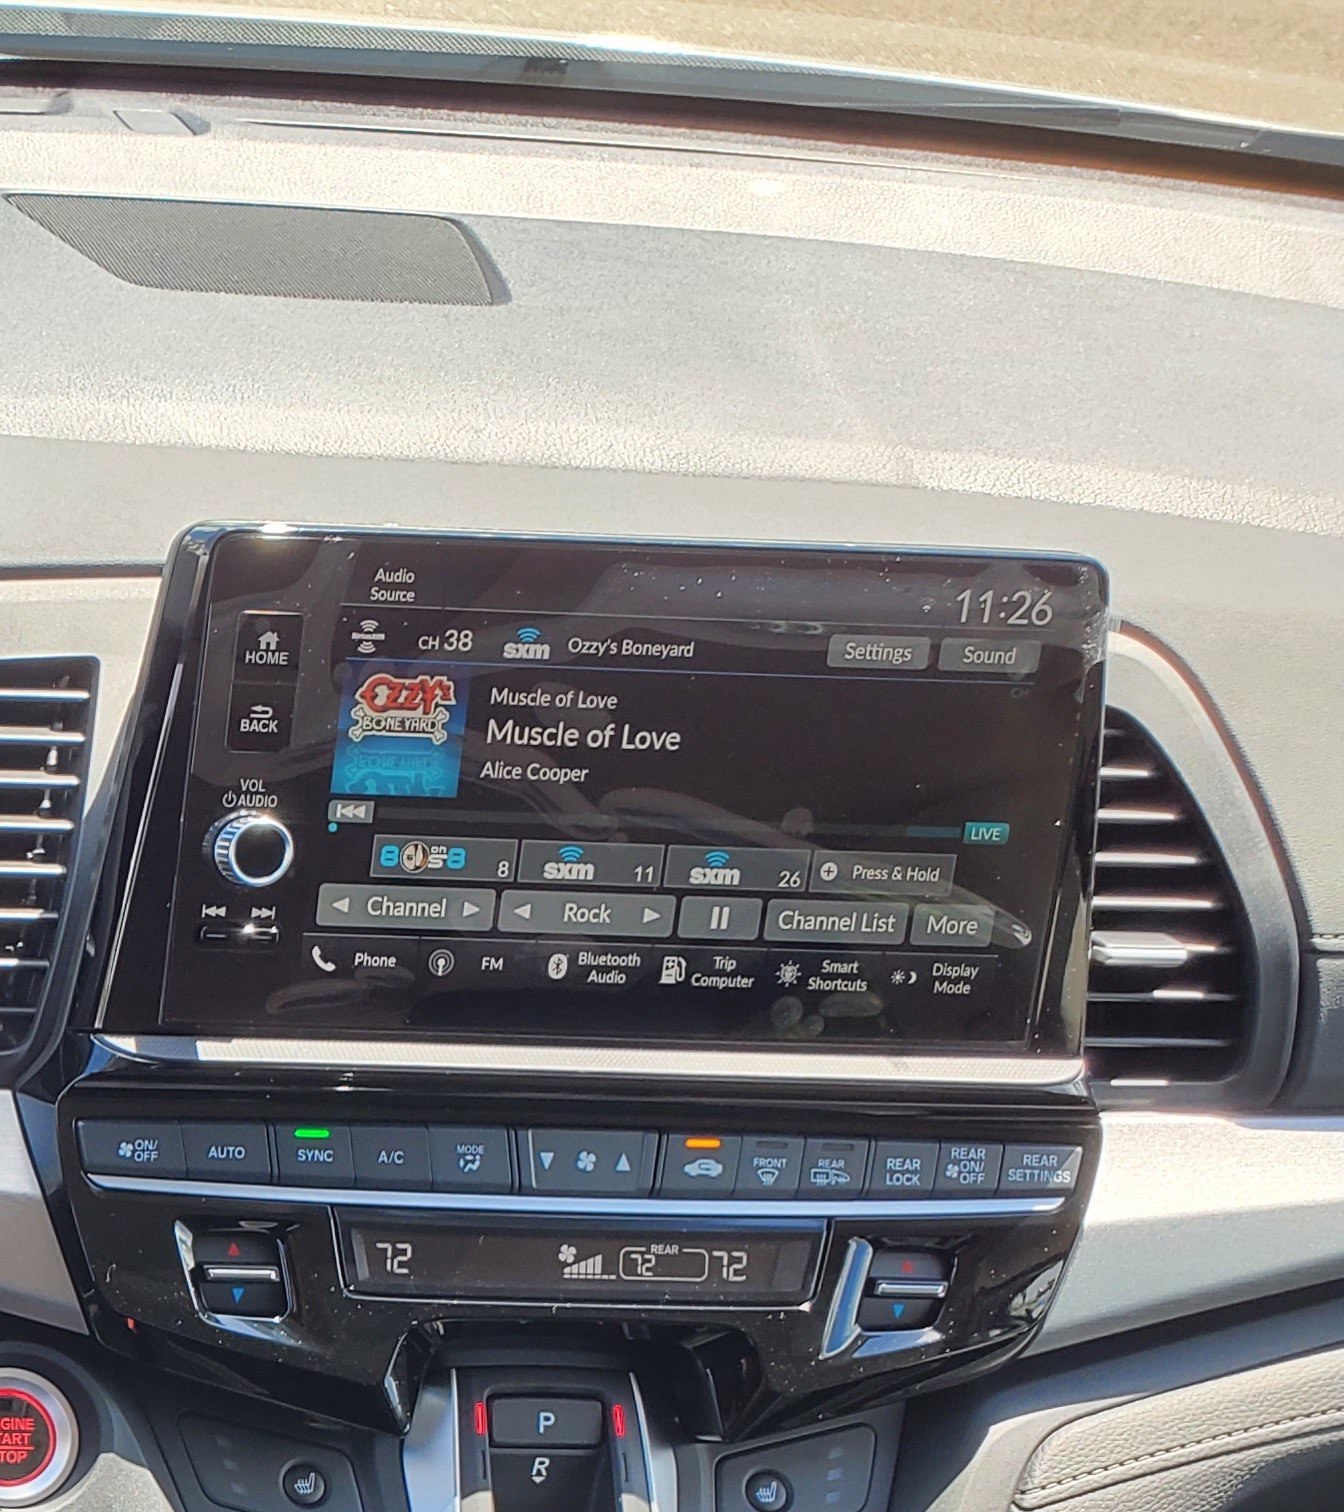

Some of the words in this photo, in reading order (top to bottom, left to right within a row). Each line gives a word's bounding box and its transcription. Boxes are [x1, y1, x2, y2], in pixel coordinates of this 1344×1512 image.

[374, 568, 415, 584] Audio
[370, 587, 416, 602] Source
[955, 588, 1055, 626] 11:26
[418, 635, 440, 651] CH
[443, 629, 474, 652] 38
[568, 636, 617, 658] Ozzy's
[621, 639, 695, 659] Boneyard
[244, 649, 290, 666] HOME
[843, 642, 913, 665] Settings
[962, 646, 1018, 666] Sound
[489, 687, 551, 707] Muscle
[555, 690, 576, 708] of
[577, 691, 618, 710] Love
[239, 718, 279, 734] BACK
[361, 716, 439, 733] BONEYARD
[486, 718, 579, 747] Muscle
[586, 723, 616, 748] of
[621, 723, 681, 751] Love
[480, 761, 522, 780] Alice
[526, 763, 590, 784] Cooper
[240, 779, 266, 793] VOL
[237, 794, 279, 809] AUDIO
[970, 826, 1001, 841] LIVE
[496, 860, 510, 878] 8
[633, 866, 654, 883] 11
[852, 864, 888, 881] Press
[891, 866, 903, 881] &
[906, 866, 941, 883] Hold
[778, 871, 801, 888] 26
[366, 896, 447, 920] Channel
[563, 903, 611, 924] Rock
[778, 911, 857, 932] Channel
[861, 912, 896, 933] List
[926, 916, 979, 936] More
[354, 953, 397, 968] Phone
[481, 956, 504, 971] FM
[578, 951, 642, 968] Bluetooth
[713, 956, 737, 972] Trip
[821, 959, 859, 974] Smart
[587, 969, 627, 985] Audio
[932, 963, 979, 980] Display
[691, 973, 755, 990] Computer
[808, 976, 868, 993] Shortcuts
[933, 980, 971, 995] Mode
[133, 1149, 159, 1163] OFF
[208, 1145, 246, 1160] AUTO
[296, 1148, 334, 1163] SYNC
[377, 1150, 405, 1166] A/C
[456, 1144, 485, 1156] MODE
[950, 1147, 986, 1161] REAR
[752, 1157, 788, 1169] FRONT
[817, 1158, 846, 1170] REAR
[885, 1157, 922, 1172] REAR
[1022, 1154, 1058, 1169] REAR
[885, 1171, 921, 1187] LOCK
[959, 1171, 986, 1185] OFF
[1008, 1167, 1072, 1185] SETTINGS
[376, 1242, 412, 1275] 72
[650, 1244, 680, 1256] REAR
[629, 1253, 657, 1276] 72
[712, 1250, 748, 1282] 72
[536, 1411, 556, 1434] P
[532, 1457, 550, 1476] R
